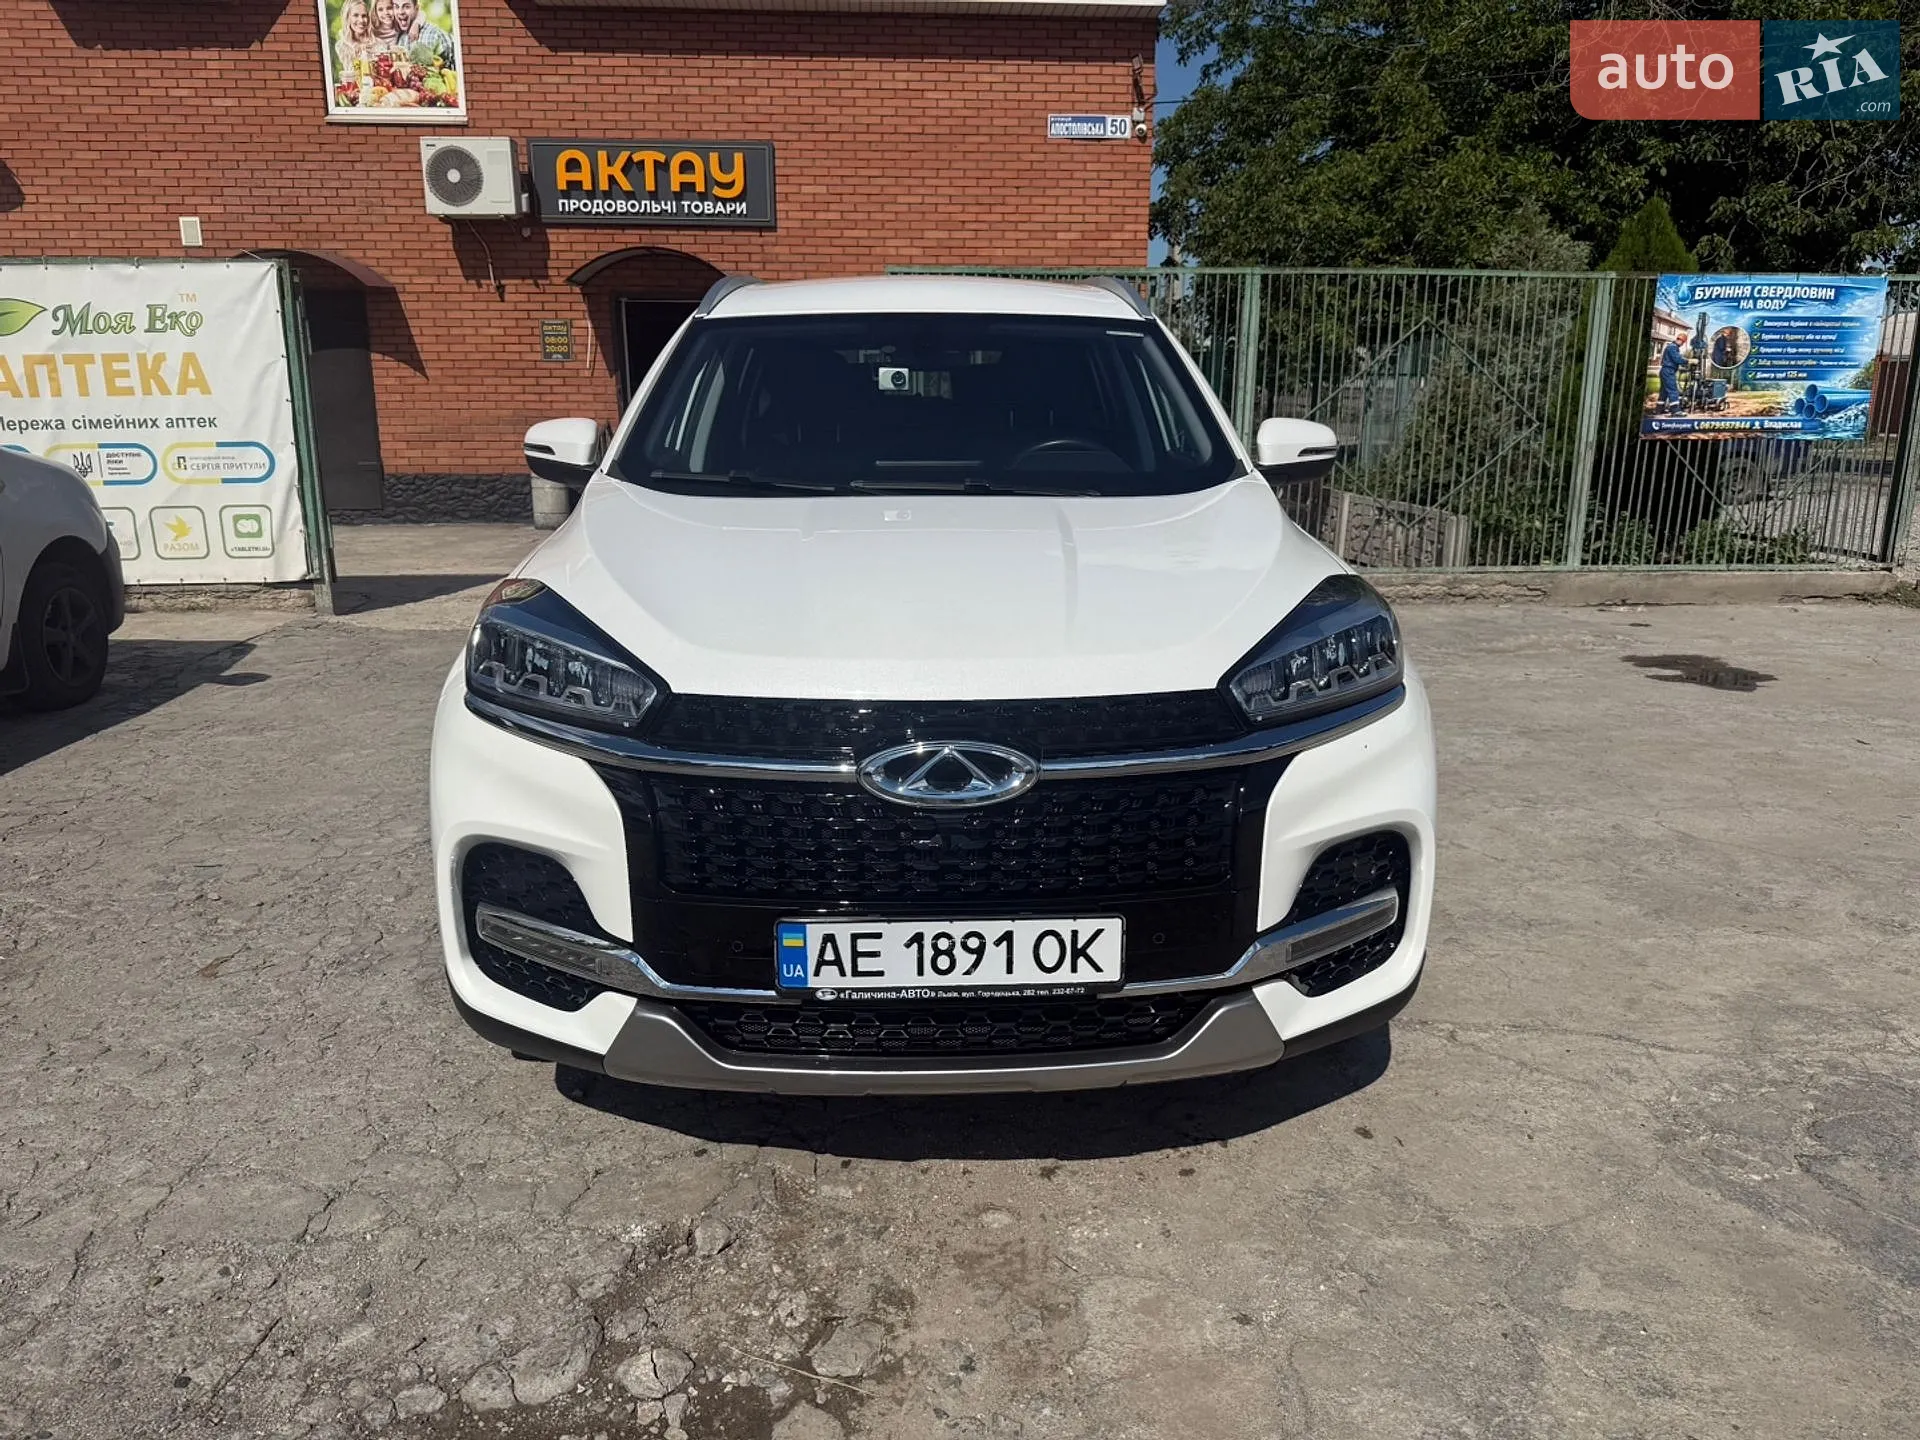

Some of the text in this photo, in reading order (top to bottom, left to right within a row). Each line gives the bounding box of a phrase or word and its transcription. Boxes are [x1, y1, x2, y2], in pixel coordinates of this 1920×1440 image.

[1110, 119, 1127, 135] 50
[556, 149, 747, 199] АКТАУ
[558, 199, 747, 215] ПРОДОВОЛЬЧІ ТОВАРИ
[179, 293, 197, 303] TM
[1694, 285, 1835, 301] БУРІННЯ СВЕРДЛОВИН
[1739, 299, 1787, 311] НА ВОДУ
[52, 302, 203, 336] Моя Еко
[0, 352, 212, 398] АПТЕКА
[72, 415, 160, 430] сімейних
[165, 416, 218, 429] аптек
[163, 542, 199, 552] РАЗОМ
[813, 928, 1105, 978] AE 1891 OK
[783, 964, 805, 979] UA
[839, 988, 936, 1000] «Галичина-АВТО»
